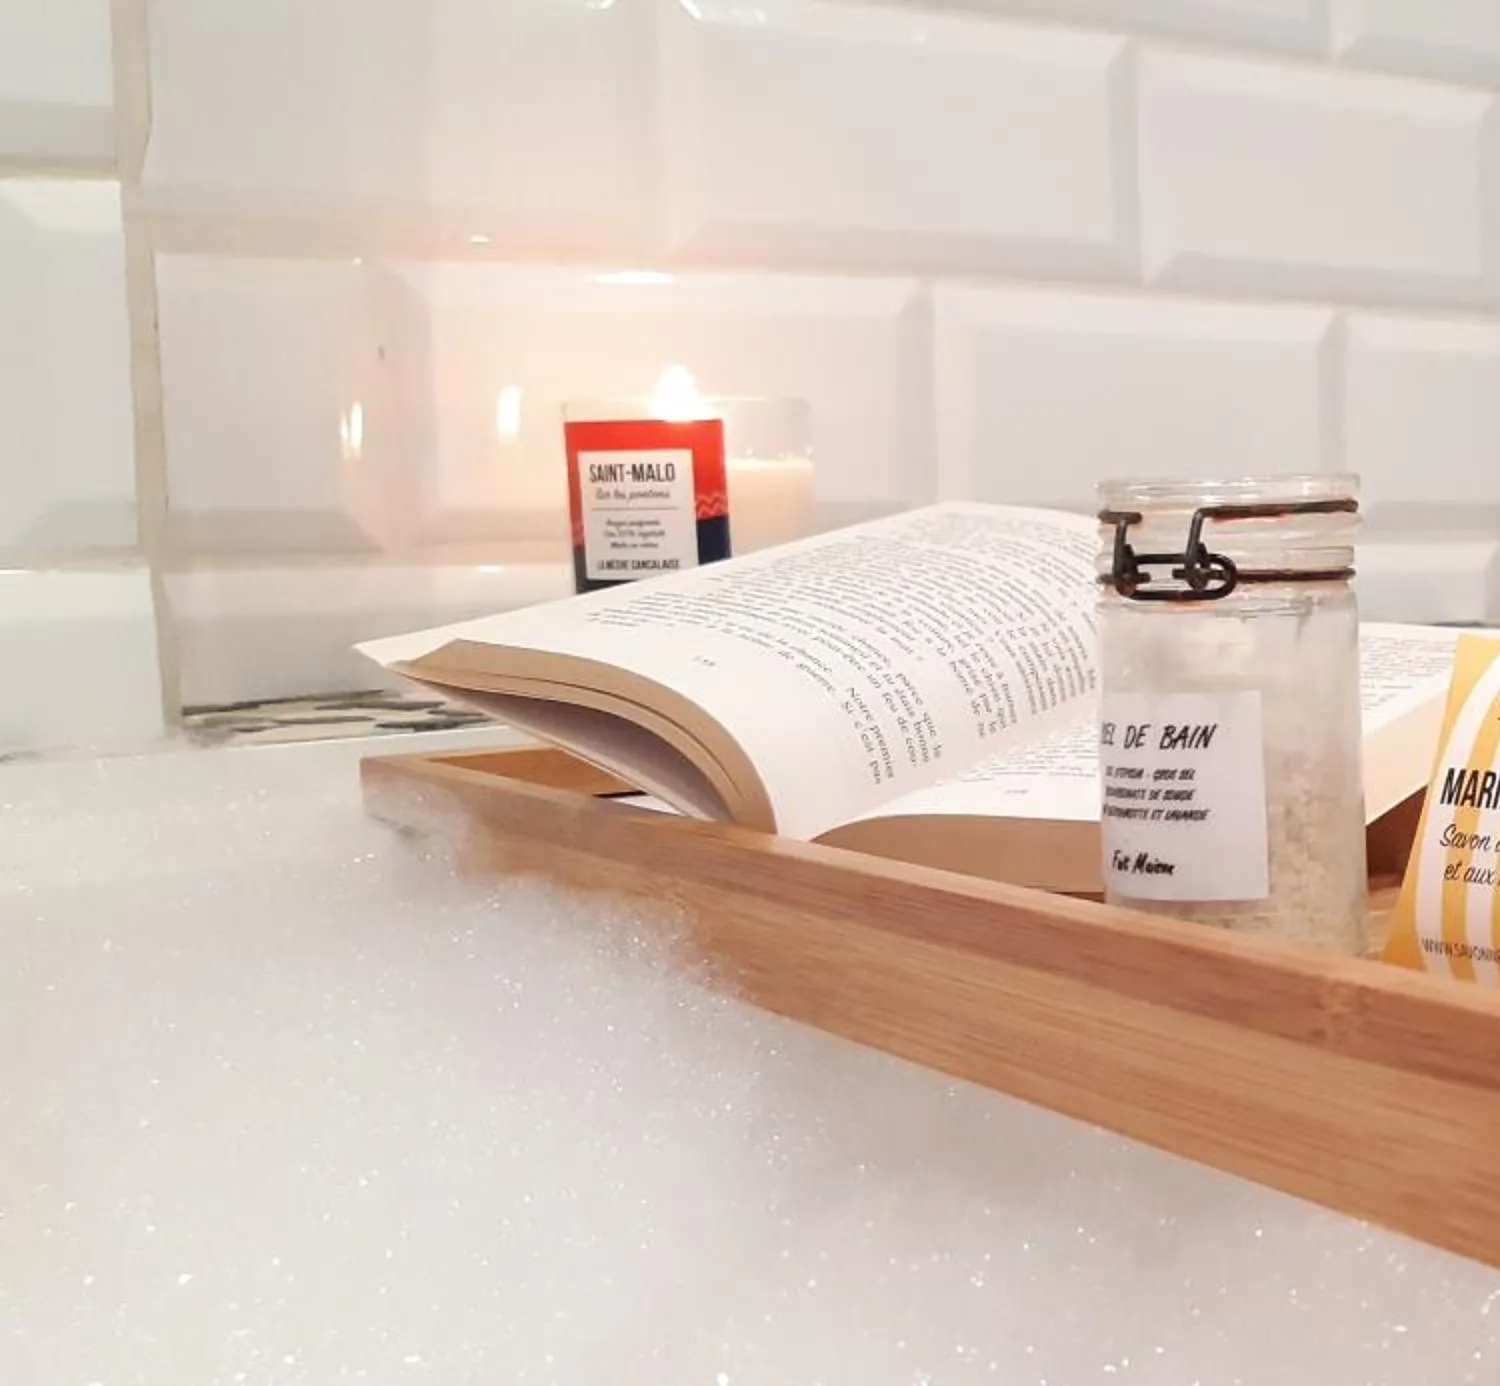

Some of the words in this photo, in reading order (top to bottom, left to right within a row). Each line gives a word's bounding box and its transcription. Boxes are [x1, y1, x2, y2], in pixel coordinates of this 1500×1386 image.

[589, 463, 676, 482] SAINT-MALO
[1124, 723, 1152, 749] DE
[1159, 723, 1217, 750] BAIN
[1439, 823, 1492, 851] Savon
[1443, 860, 1464, 881] et
[1463, 867, 1494, 885] aux
